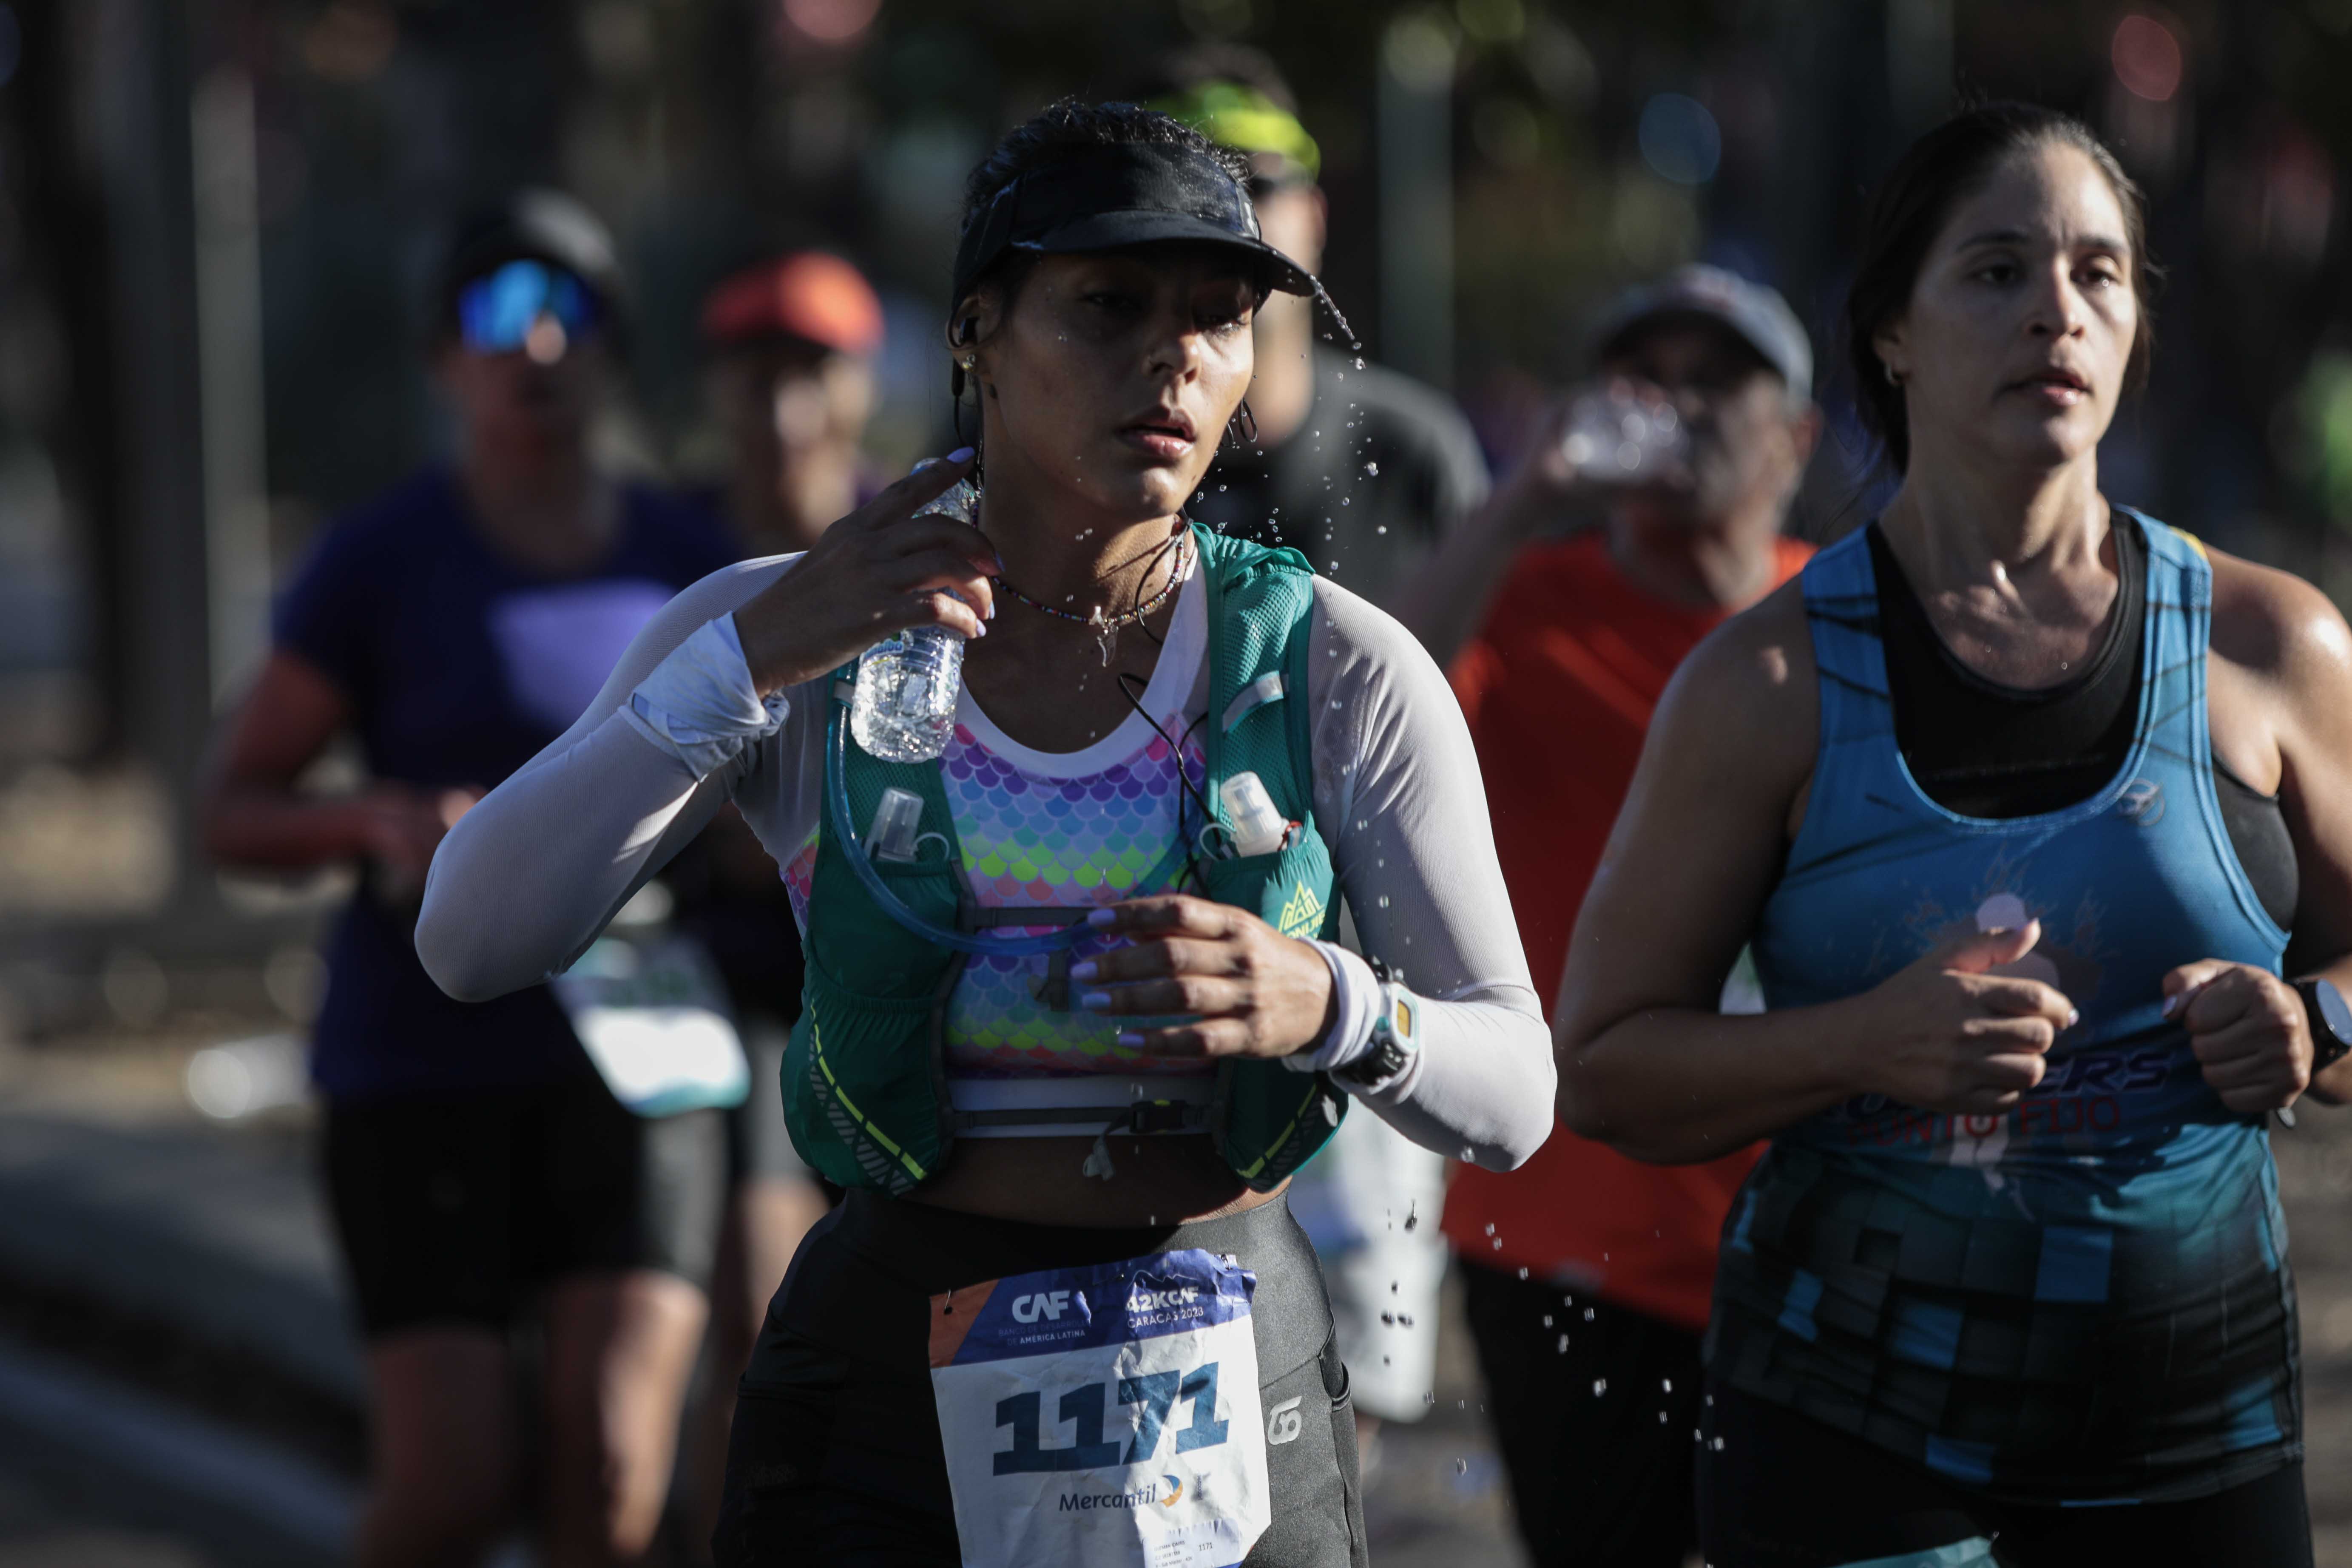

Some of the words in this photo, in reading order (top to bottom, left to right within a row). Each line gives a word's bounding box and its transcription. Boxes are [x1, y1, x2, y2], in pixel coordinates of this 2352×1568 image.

[2020, 1096, 2119, 1135] FIJO
[1012, 1290, 1071, 1324] CAF
[1128, 1312, 1178, 1329] CARACAS
[1182, 1307, 1204, 1320] 2023
[1057, 1329, 1085, 1340] LATINA
[993, 1362, 1229, 1476] 1171
[1059, 1483, 1156, 1512] Mercantil
[1199, 1542, 1213, 1551] 1171
